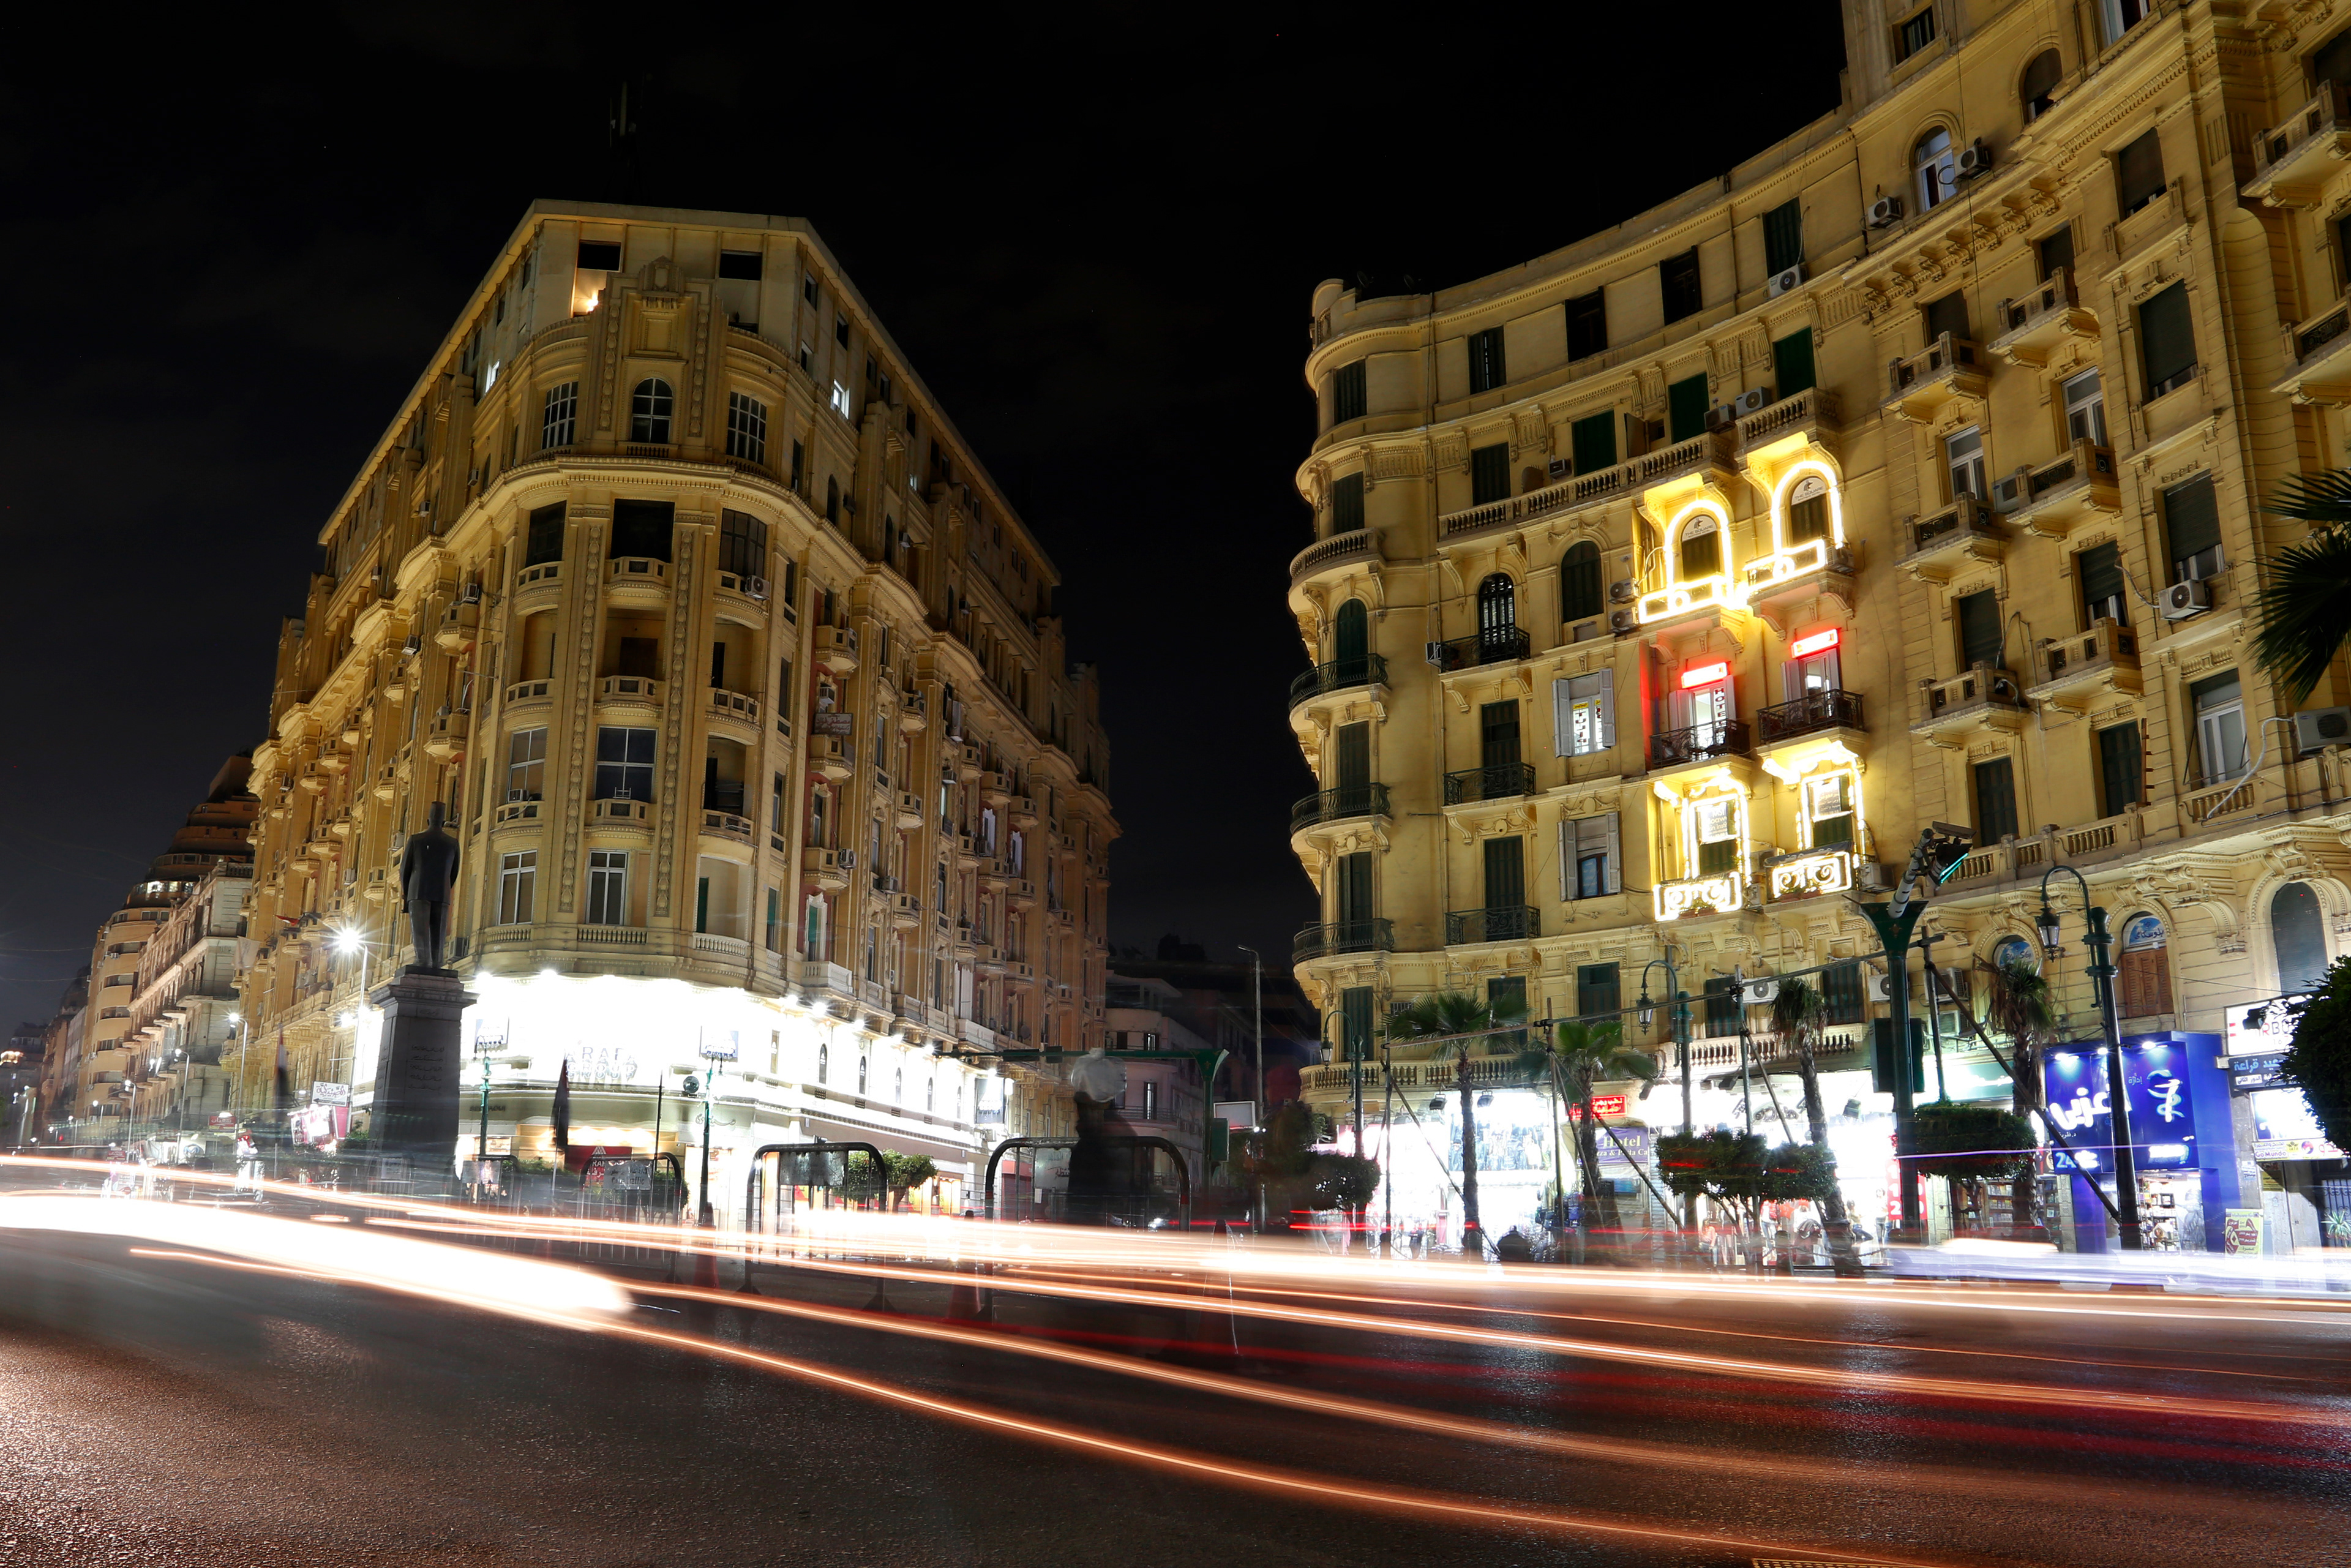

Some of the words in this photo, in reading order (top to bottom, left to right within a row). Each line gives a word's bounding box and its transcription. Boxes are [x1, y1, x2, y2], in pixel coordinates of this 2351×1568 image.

[1714, 688, 1727, 728] HOTEL
[2019, 950, 2031, 959] Sky
[2234, 1058, 2259, 1073] قراعة
[2055, 1152, 2077, 1168] 24
